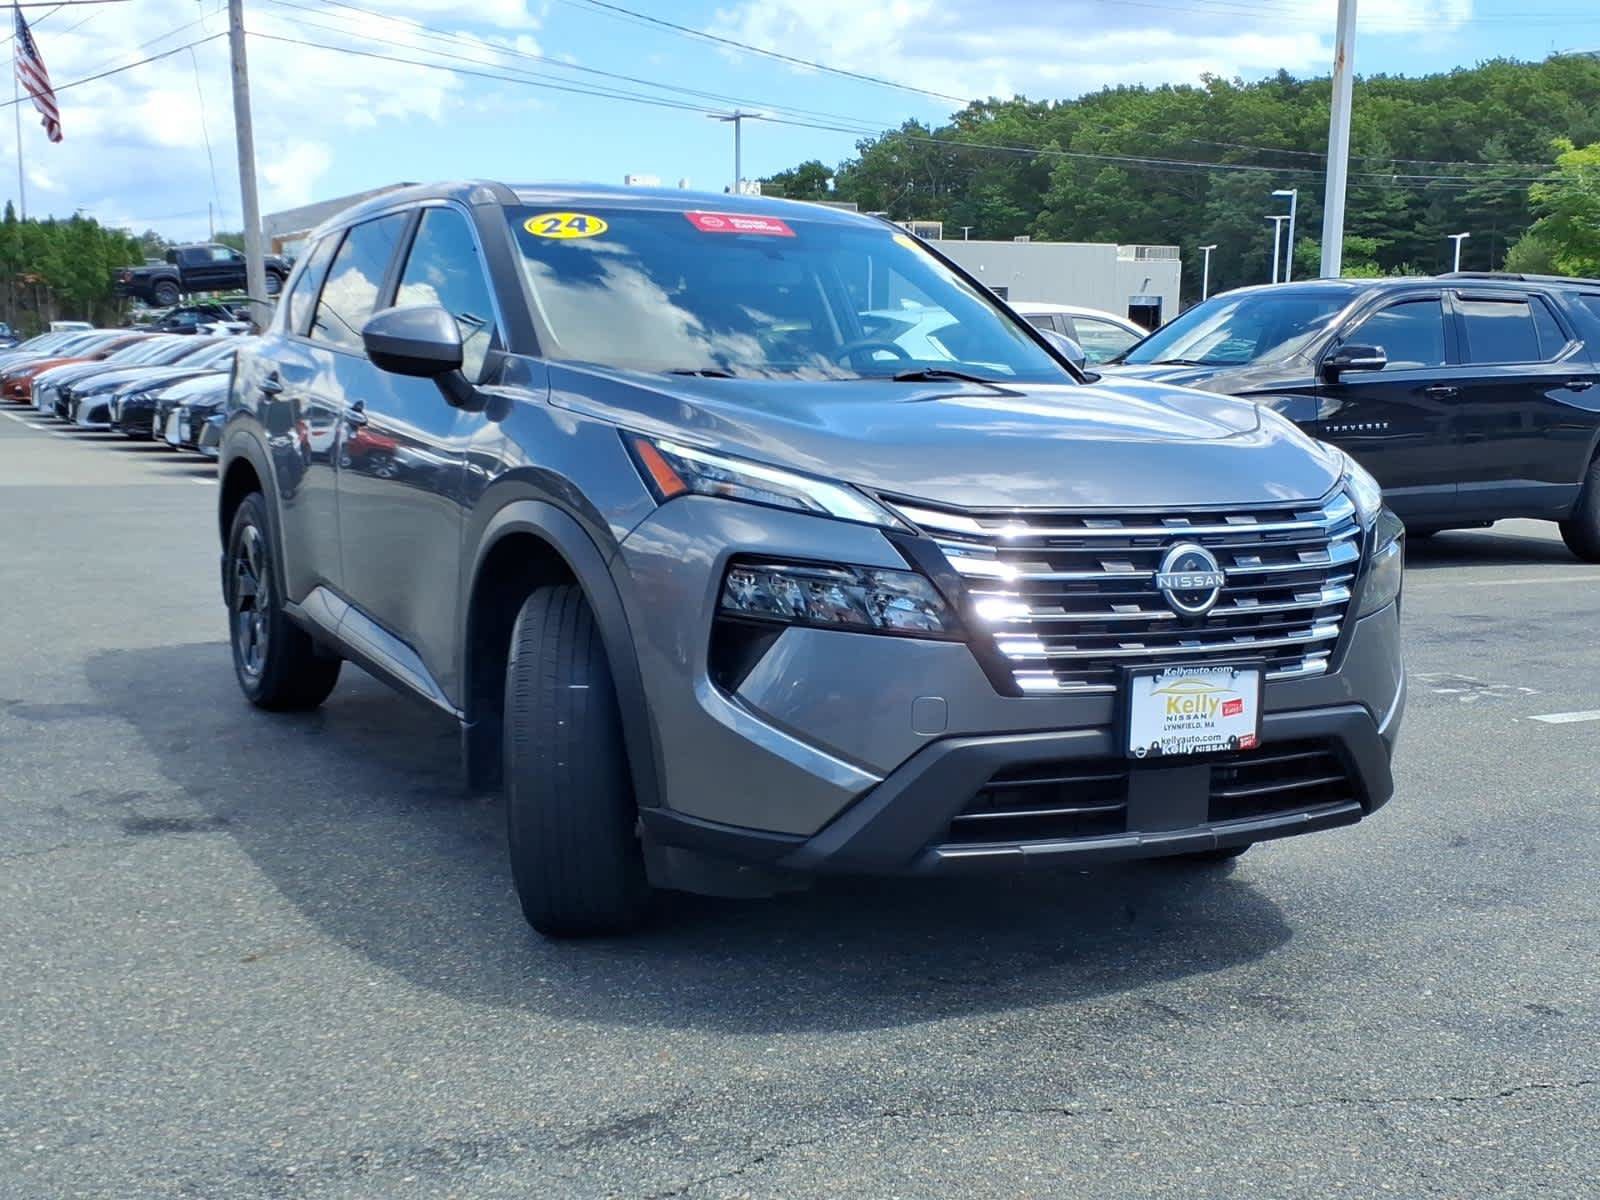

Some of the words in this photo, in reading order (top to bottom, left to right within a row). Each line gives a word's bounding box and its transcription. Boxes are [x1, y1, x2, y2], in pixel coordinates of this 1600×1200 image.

[541, 217, 587, 233] 24
[1159, 574, 1224, 588] NISSAN
[1163, 666, 1233, 678] Kellyauto.com
[1166, 694, 1220, 719] Kelly
[1166, 713, 1208, 722] NISSAN
[1161, 734, 1222, 745] kellyauto.com
[1161, 743, 1194, 755] Kelly
[1195, 743, 1231, 753] NISSAN
